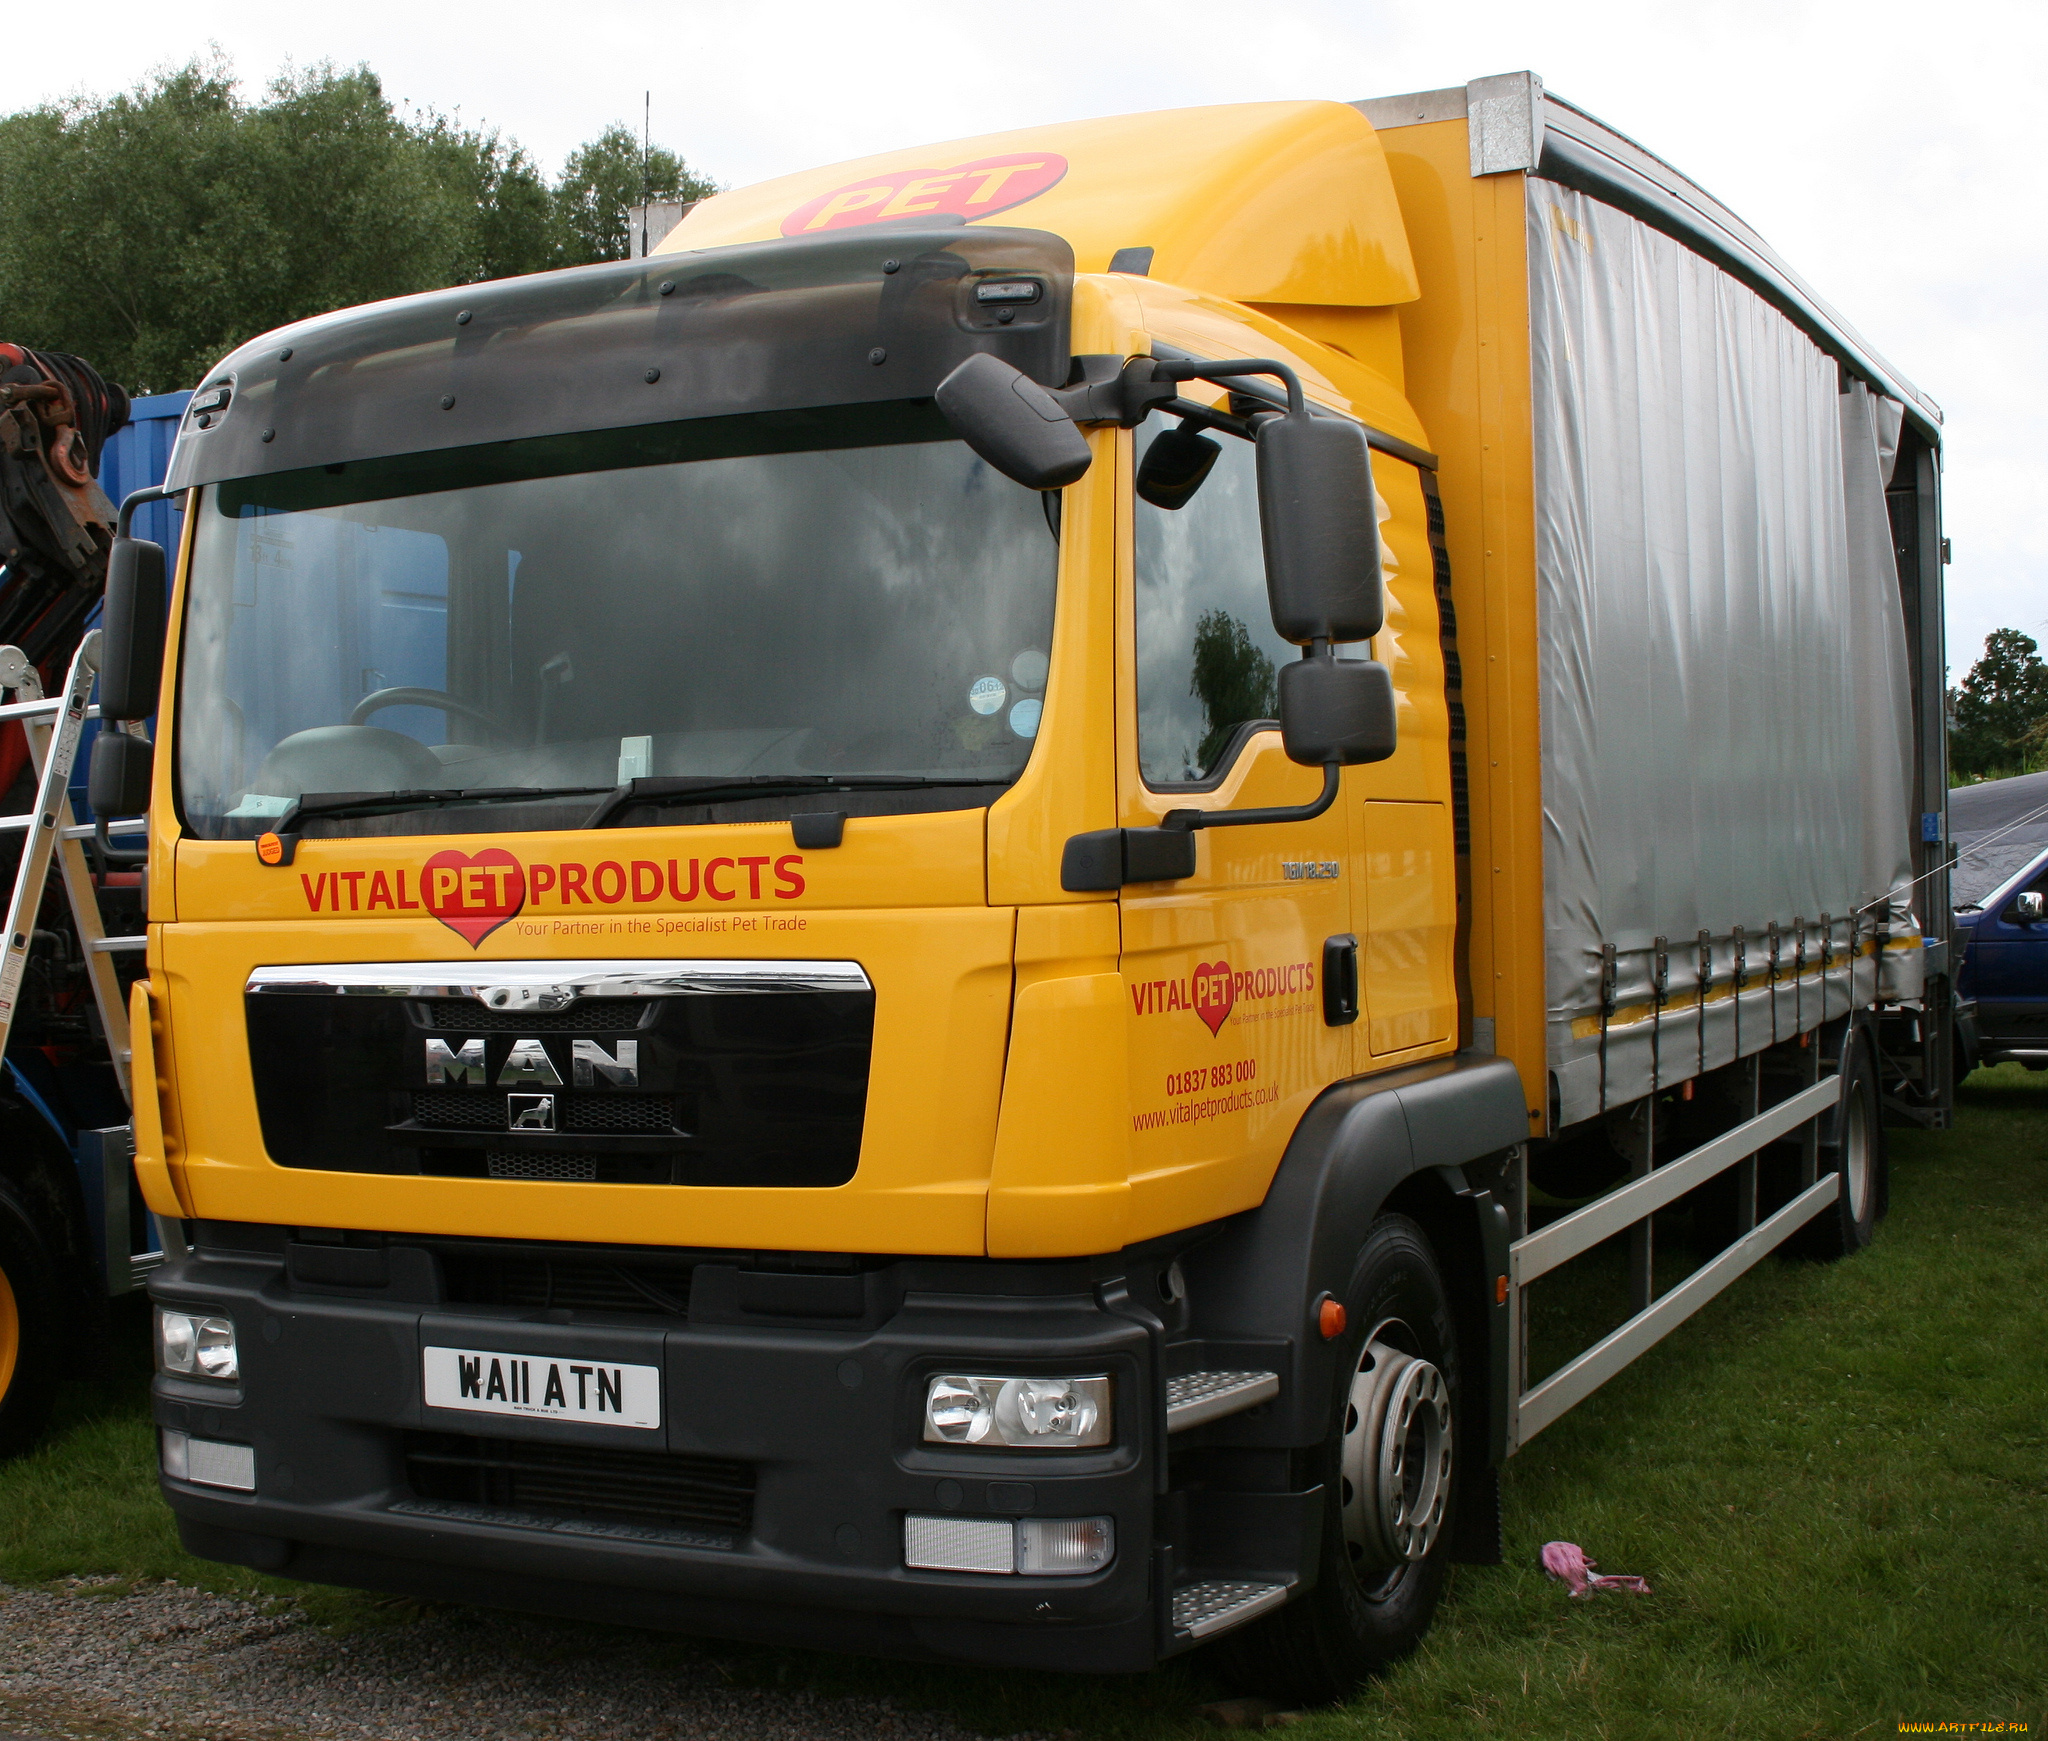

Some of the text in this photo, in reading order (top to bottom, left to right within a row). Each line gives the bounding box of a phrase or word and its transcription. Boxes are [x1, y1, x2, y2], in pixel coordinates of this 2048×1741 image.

[803, 162, 1046, 231] PET
[980, 680, 994, 693] 06
[301, 855, 806, 912] VITAL PET PRODUCTS
[1282, 861, 1304, 879] TGM
[516, 913, 807, 936] Your Partner in the Specialist Pet Trade
[1131, 962, 1314, 1015] VITAL PET PRODUCTS
[1230, 1016, 1241, 1026] Your
[1242, 1013, 1260, 1023] Partner
[425, 1038, 639, 1087] MAN
[1166, 1058, 1257, 1097] 01837 883 000
[1132, 1080, 1280, 1132] www.vitalpetproducts.co.uk
[457, 1354, 623, 1414] WA11 ATN
